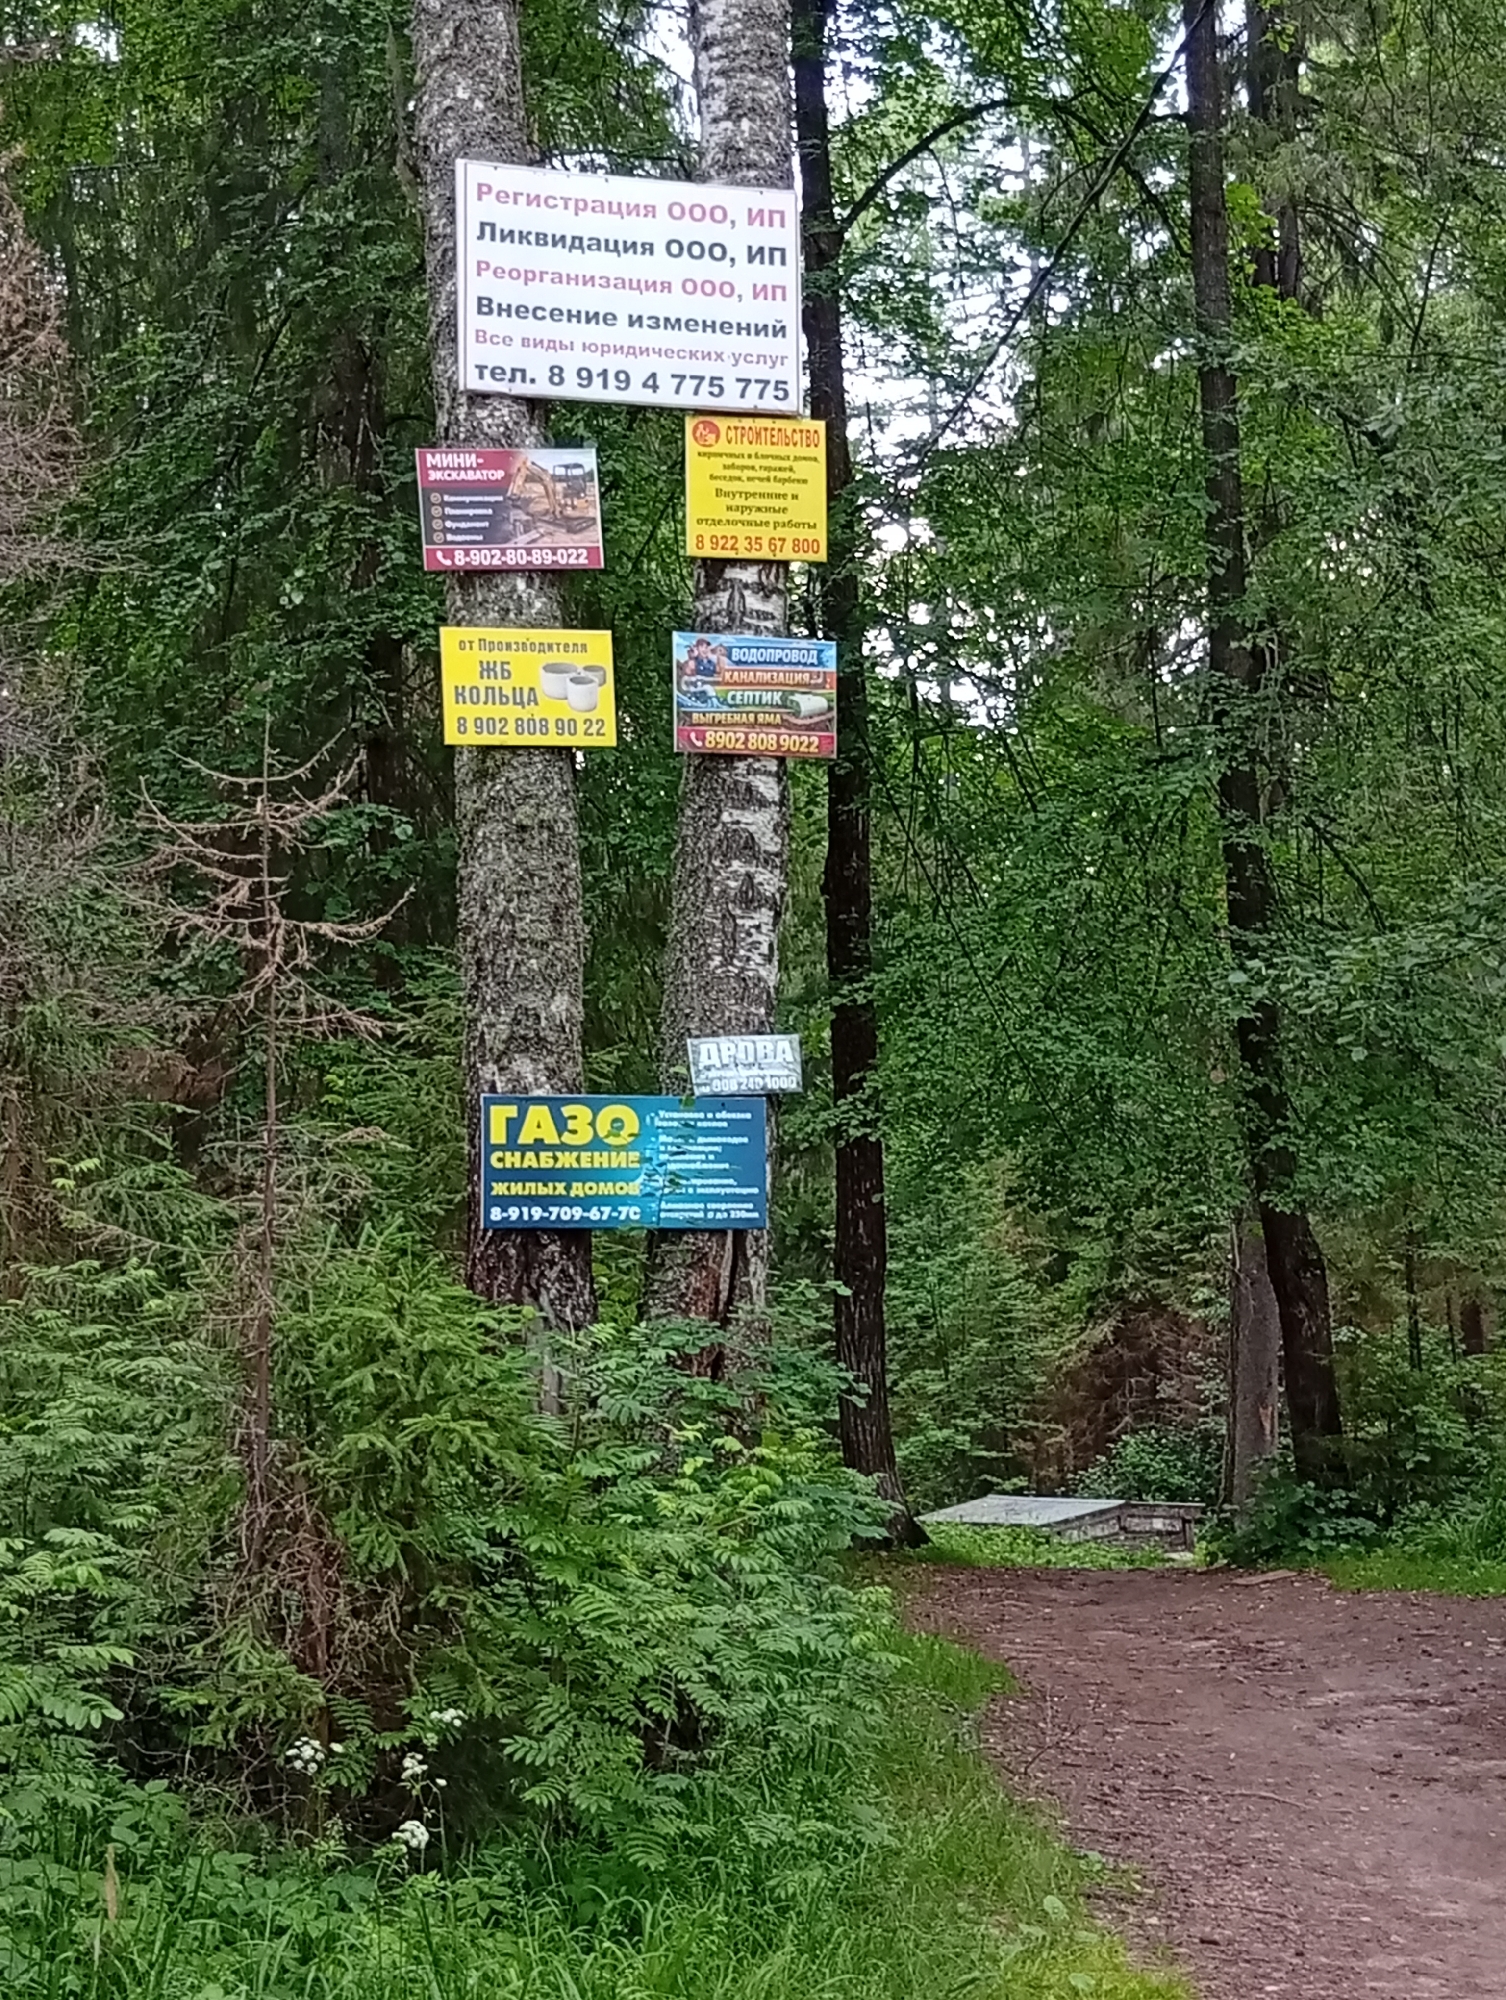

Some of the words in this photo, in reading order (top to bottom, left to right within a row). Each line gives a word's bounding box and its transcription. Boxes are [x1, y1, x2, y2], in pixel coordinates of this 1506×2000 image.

[476, 182, 657, 219] Регистрация
[668, 202, 737, 229] ООО,
[747, 208, 786, 228] ИП
[476, 221, 655, 257] Ликвидация
[665, 239, 737, 268] ООО,
[747, 245, 787, 266] ИП
[475, 260, 672, 295] Реорганизация
[681, 278, 743, 301] ООО,
[752, 283, 788, 301] ИП
[476, 296, 618, 326] Внесение
[627, 314, 787, 339] изменений
[474, 329, 514, 347] Все
[521, 336, 574, 352] виды
[582, 341, 725, 363] юридических
[731, 352, 788, 368] услуг
[474, 364, 536, 384] тел.
[548, 365, 565, 387] 8
[576, 367, 631, 391] 919
[642, 372, 660, 393] 4
[671, 374, 725, 398] 775
[735, 378, 790, 401] 775
[726, 425, 820, 448] СТРОИТЕЛЬСТВО
[426, 453, 485, 468] МИНИ-
[427, 469, 505, 481] ЭКСКАВАТОР
[715, 487, 788, 501] Внутренние
[791, 493, 799, 501] и
[726, 504, 788, 515] наружные
[696, 518, 770, 529] отделочные
[773, 519, 817, 530] работы
[695, 534, 705, 550] 8
[710, 535, 739, 551] 922
[744, 536, 763, 552] 35
[768, 537, 787, 553] 67
[792, 538, 821, 554] 800
[454, 548, 588, 566] 8-902-80-89-022
[459, 640, 475, 651] от
[478, 638, 588, 654] Производителя
[731, 648, 818, 665] ВОДОПРОВОД
[479, 660, 512, 681] ЖБ
[724, 671, 810, 685] КАНАЛИЗАЦИЯ
[454, 685, 539, 709] КОЛЬЦА
[727, 691, 783, 705] СЕПТИК
[457, 717, 468, 735] 8
[474, 717, 509, 736] 902
[515, 717, 549, 736] 808
[555, 718, 578, 736] 90
[583, 718, 606, 737] 22
[692, 713, 755, 725] ВЫГРЕБНАЯ
[757, 714, 782, 725] ЯМА
[705, 731, 745, 749] 8902
[748, 733, 778, 750] 808
[779, 735, 819, 753] 9022
[698, 1041, 794, 1069] ДРОВА
[490, 1104, 640, 1146] ГАЗО
[490, 1151, 641, 1169] СНАБЖЕНИЕ
[491, 1182, 567, 1196] ЖИЛЫХ
[569, 1182, 641, 1197] ДОМОВ
